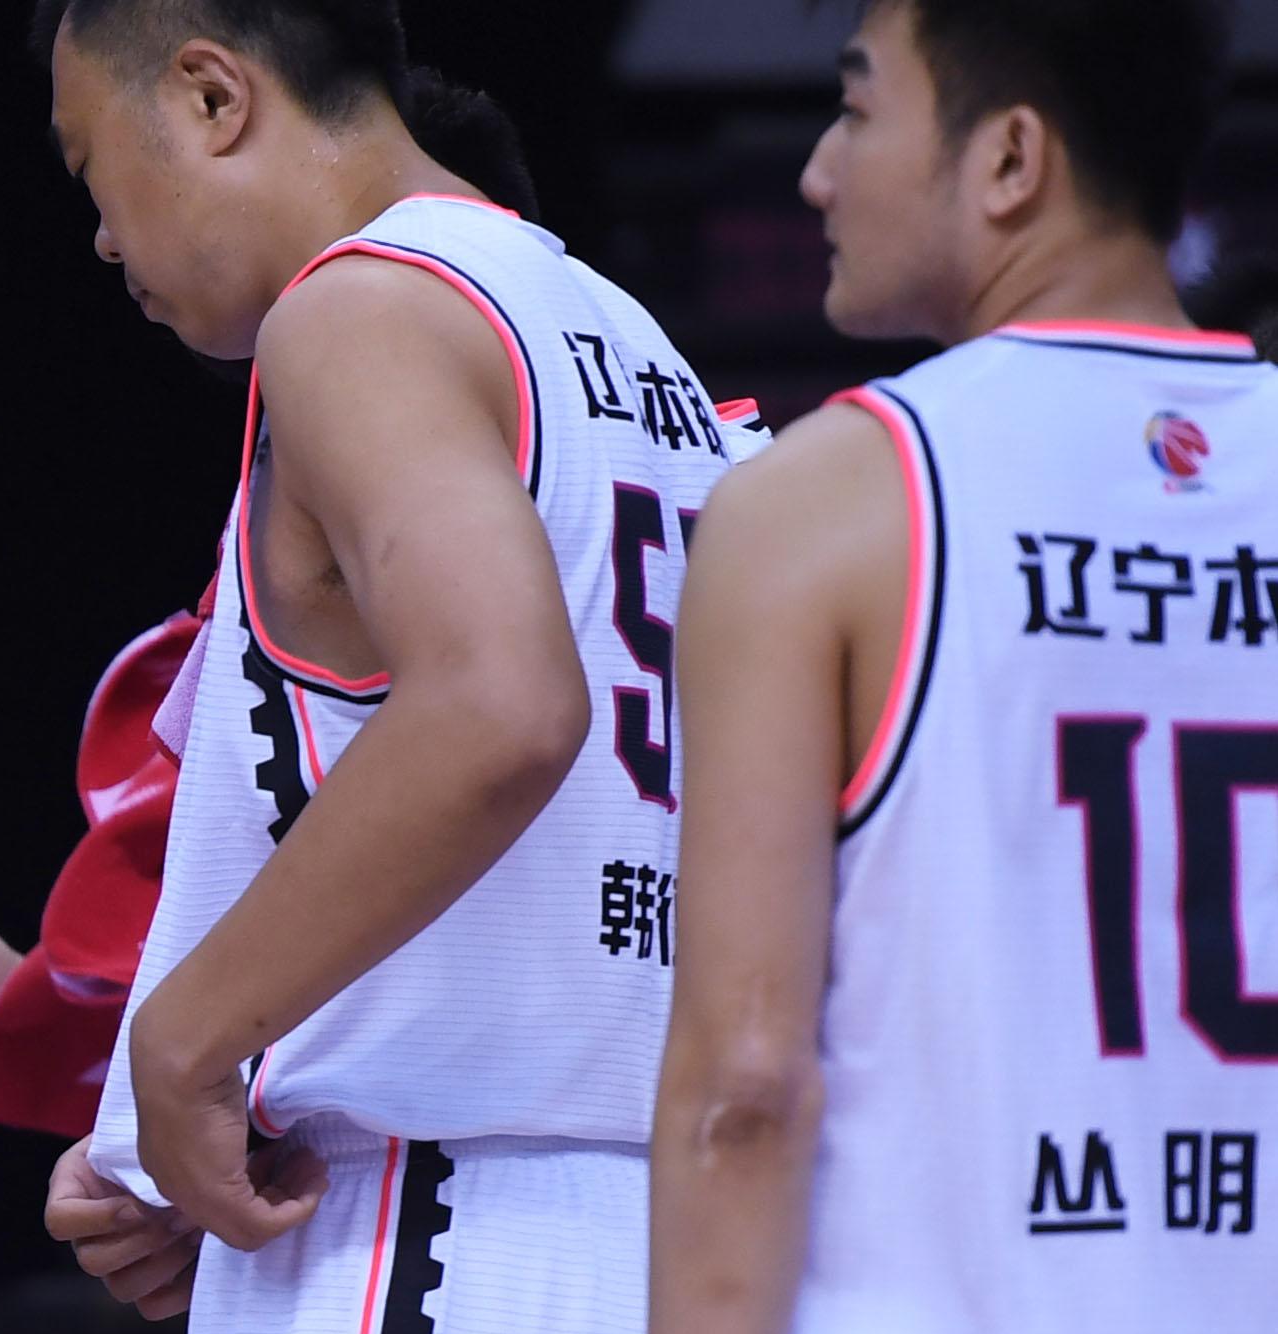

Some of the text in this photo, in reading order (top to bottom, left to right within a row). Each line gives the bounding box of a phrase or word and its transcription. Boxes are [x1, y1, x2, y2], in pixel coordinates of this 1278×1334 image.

[612, 480, 699, 814] 5
[1016, 533, 1278, 645] 辽宁本
